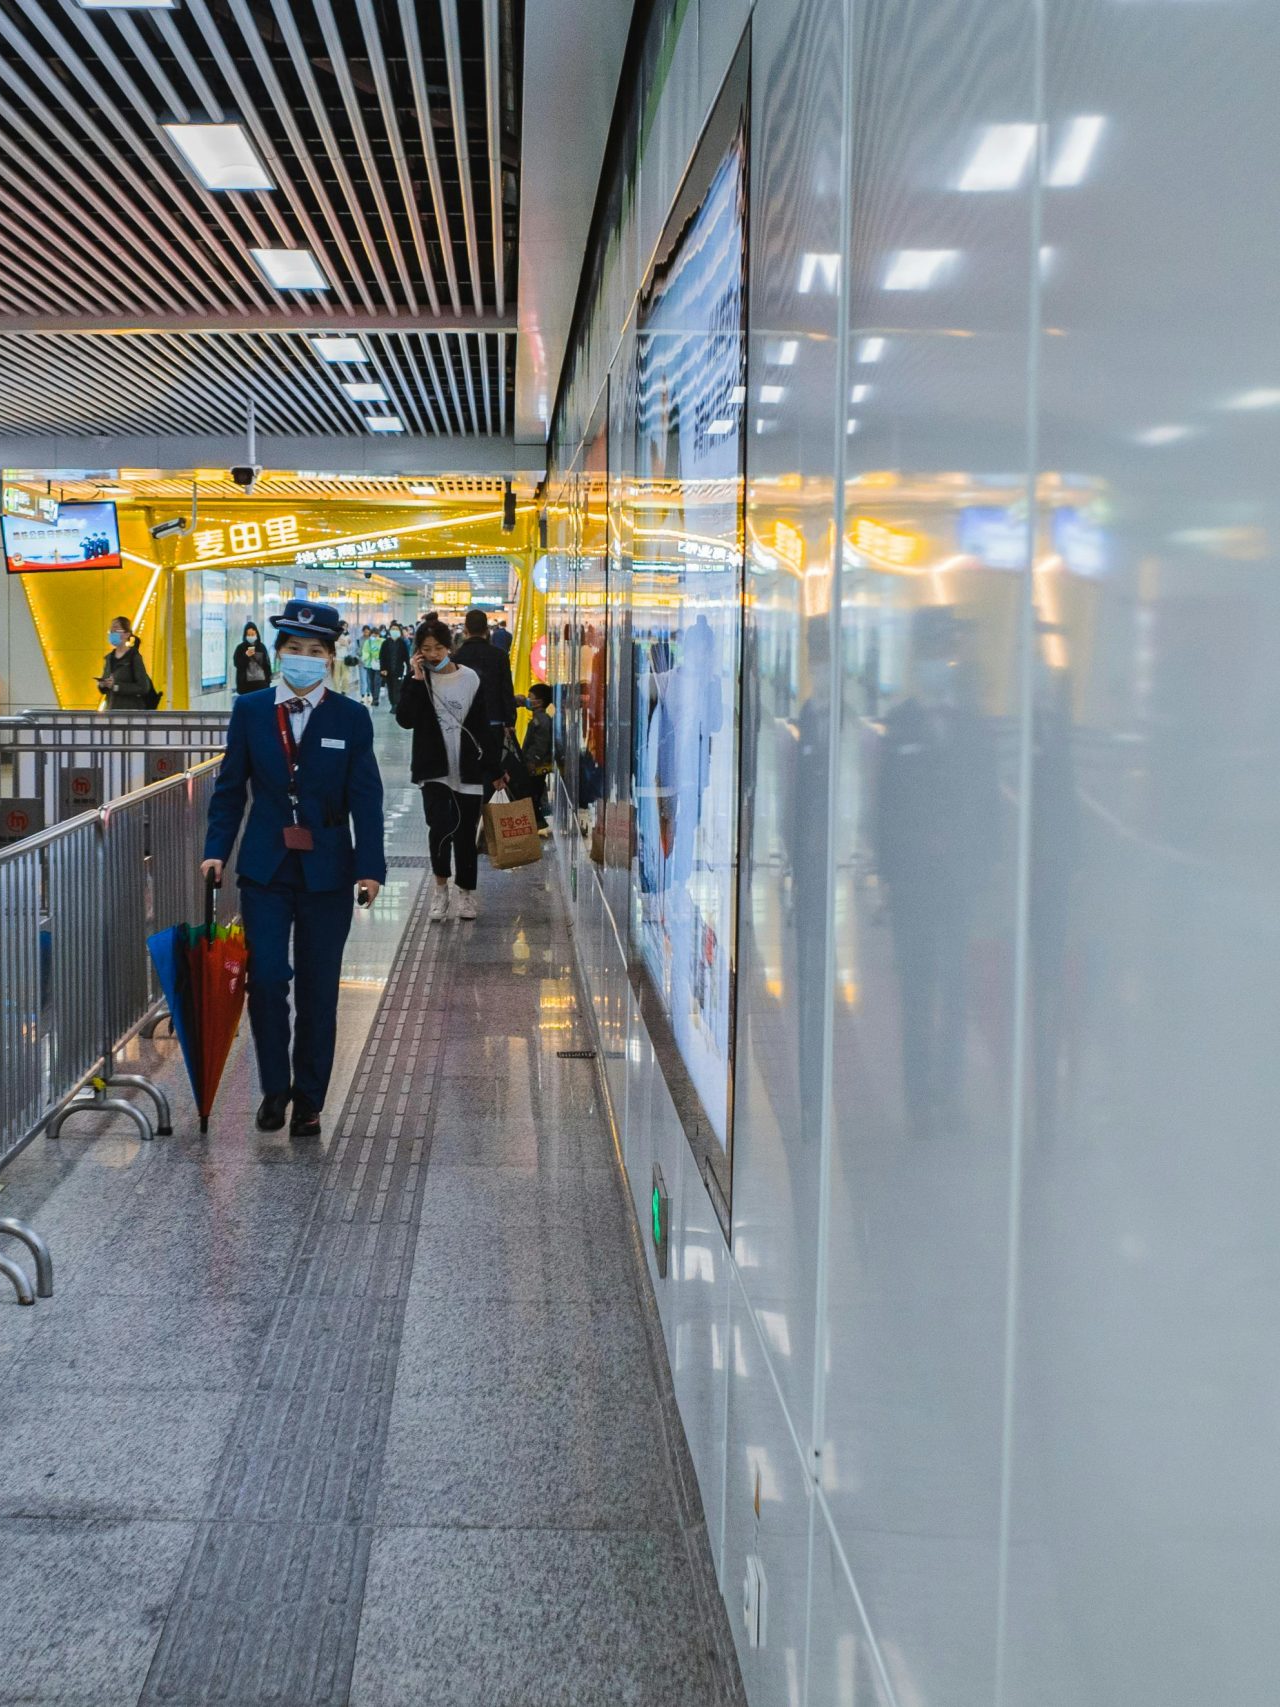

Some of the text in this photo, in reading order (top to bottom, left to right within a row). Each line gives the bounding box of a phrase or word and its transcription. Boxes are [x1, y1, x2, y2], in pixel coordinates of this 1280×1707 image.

[192, 514, 300, 560] 麦田里
[294, 535, 400, 566] 地铁商业街
